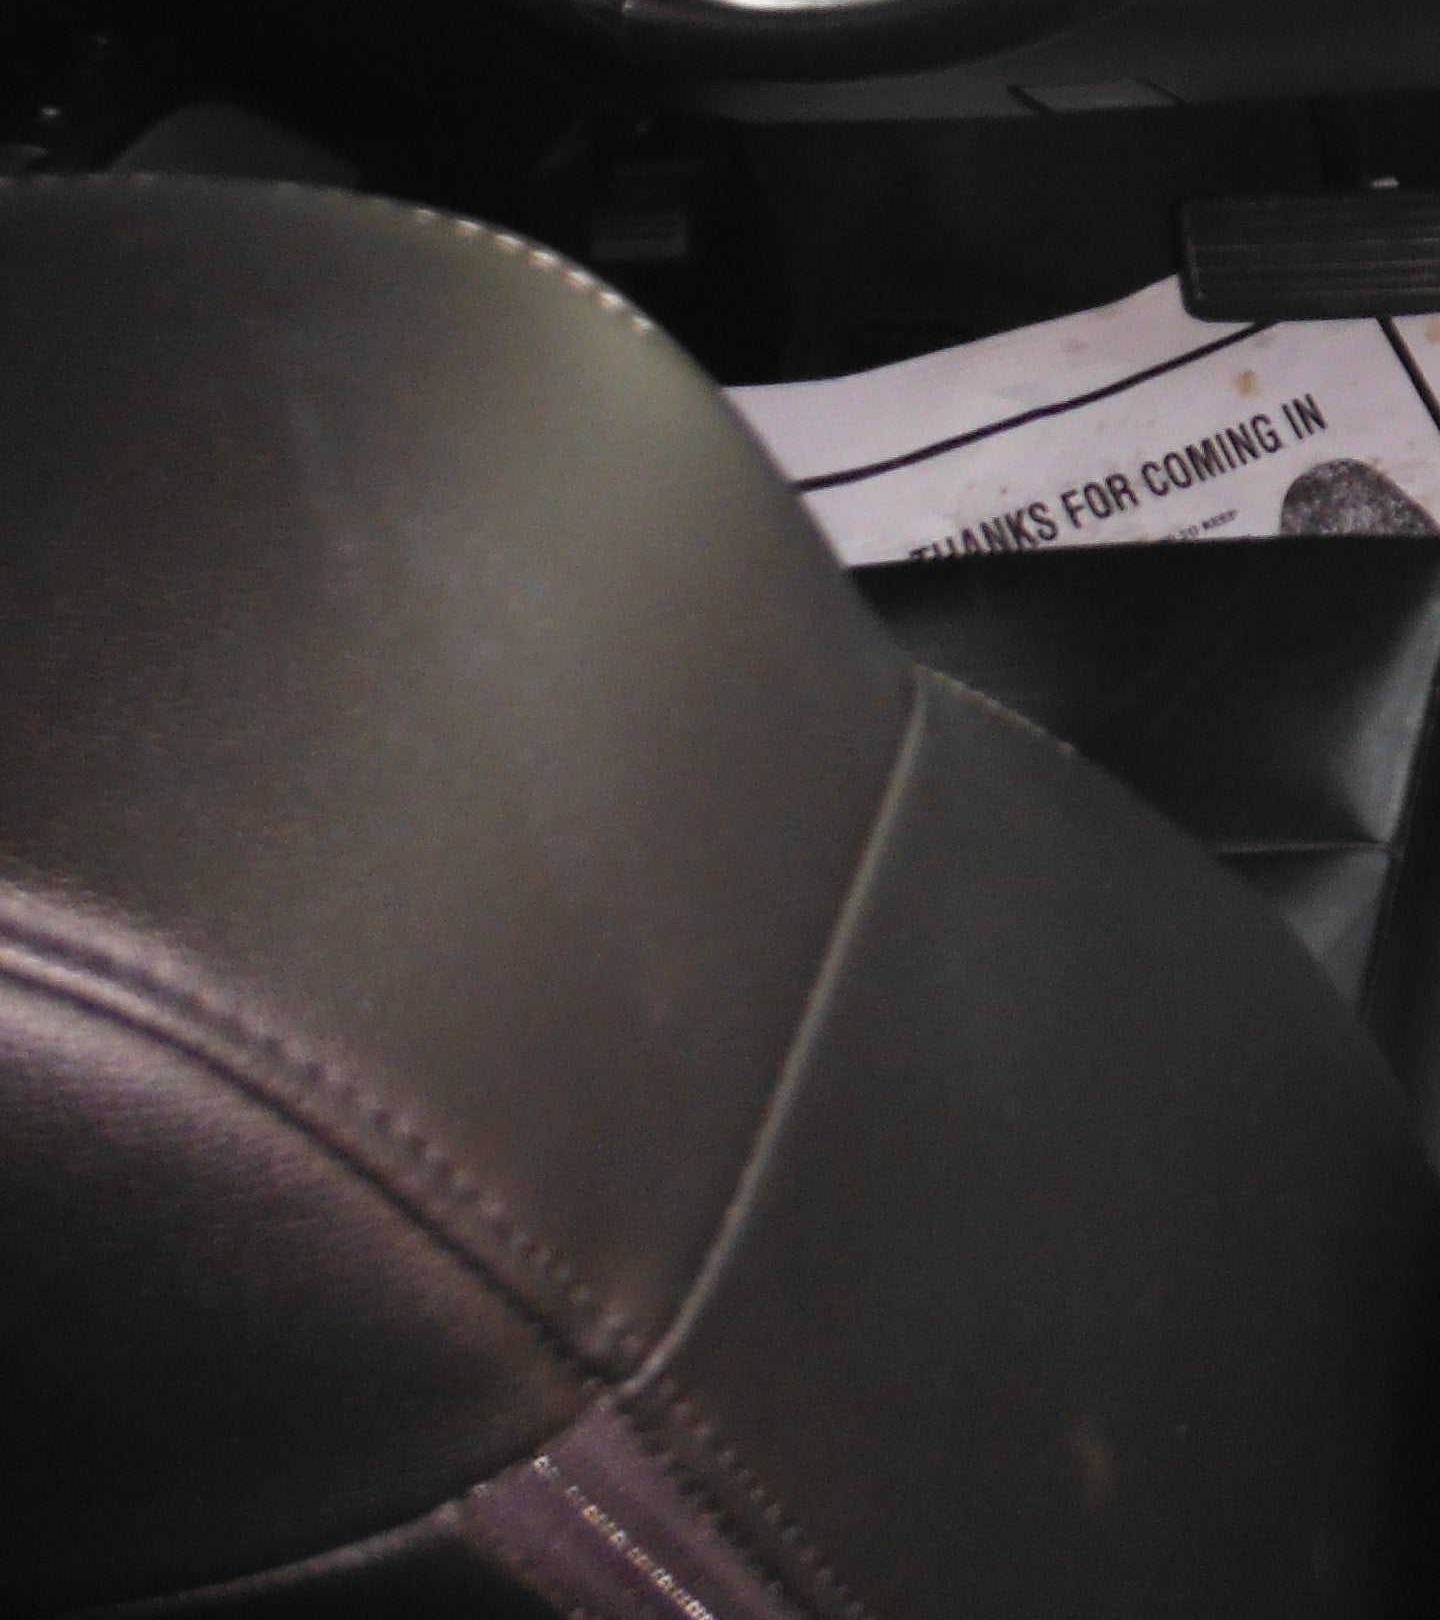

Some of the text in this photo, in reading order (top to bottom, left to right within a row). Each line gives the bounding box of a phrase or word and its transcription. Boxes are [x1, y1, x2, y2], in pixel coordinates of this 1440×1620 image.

[1061, 473, 1140, 529] FOR
[1141, 413, 1284, 498] COMING
[1281, 392, 1329, 441] IN
